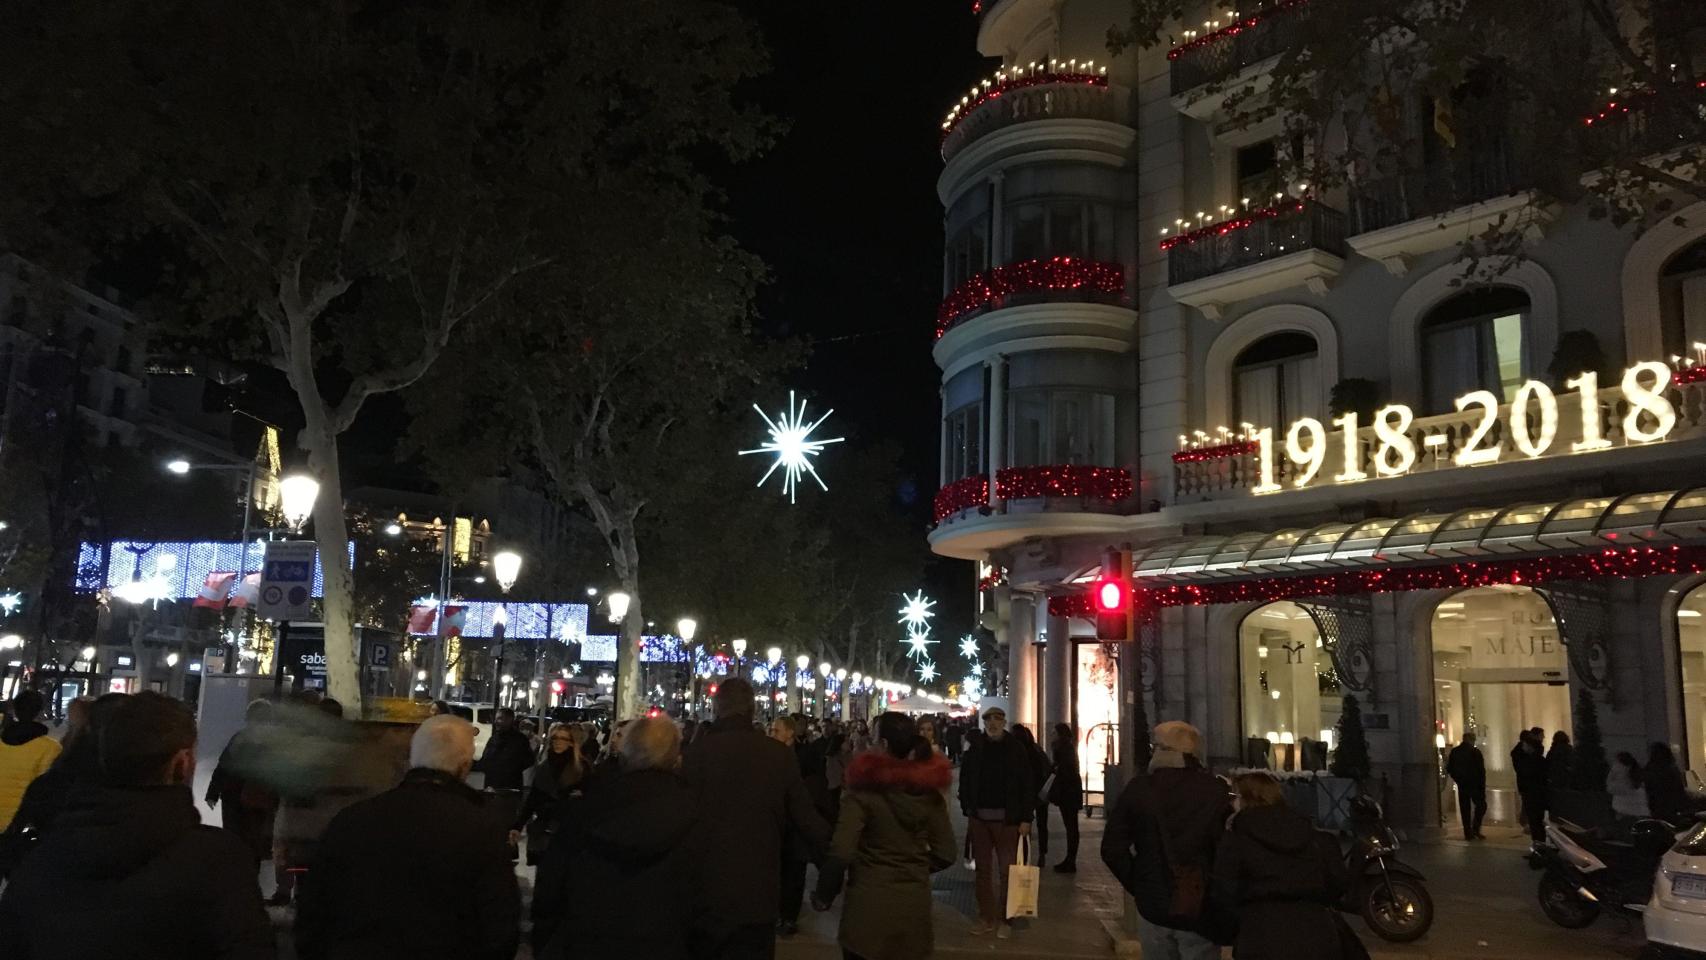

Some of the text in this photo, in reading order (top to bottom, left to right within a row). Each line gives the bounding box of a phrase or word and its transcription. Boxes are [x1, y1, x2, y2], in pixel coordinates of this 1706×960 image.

[1253, 361, 1676, 494] 1918-2018
[300, 652, 327, 664] saba
[374, 645, 387, 665] P
